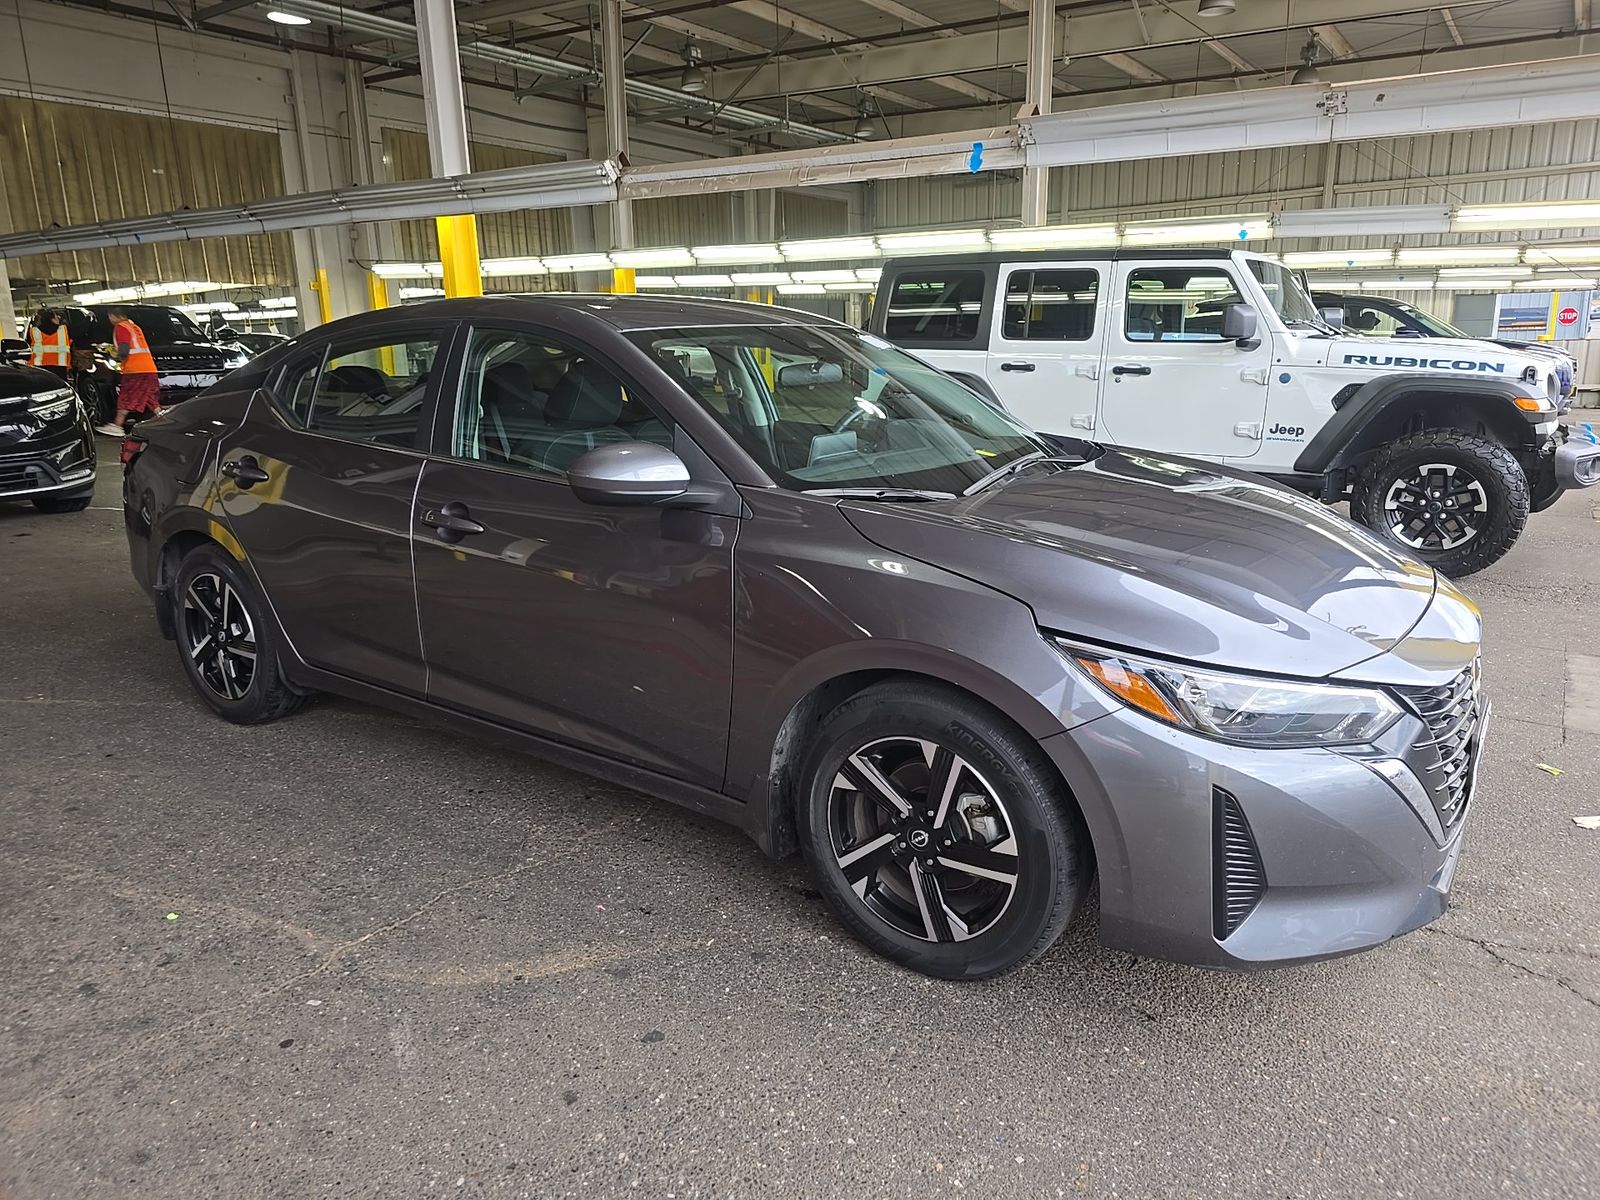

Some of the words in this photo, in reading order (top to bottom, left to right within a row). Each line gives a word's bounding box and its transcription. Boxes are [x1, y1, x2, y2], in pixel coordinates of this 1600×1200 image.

[1559, 312, 1577, 320] STOP
[1343, 354, 1505, 373] RUBICON
[1269, 423, 1305, 437] Jeep
[944, 722, 1013, 778] KINERGY
